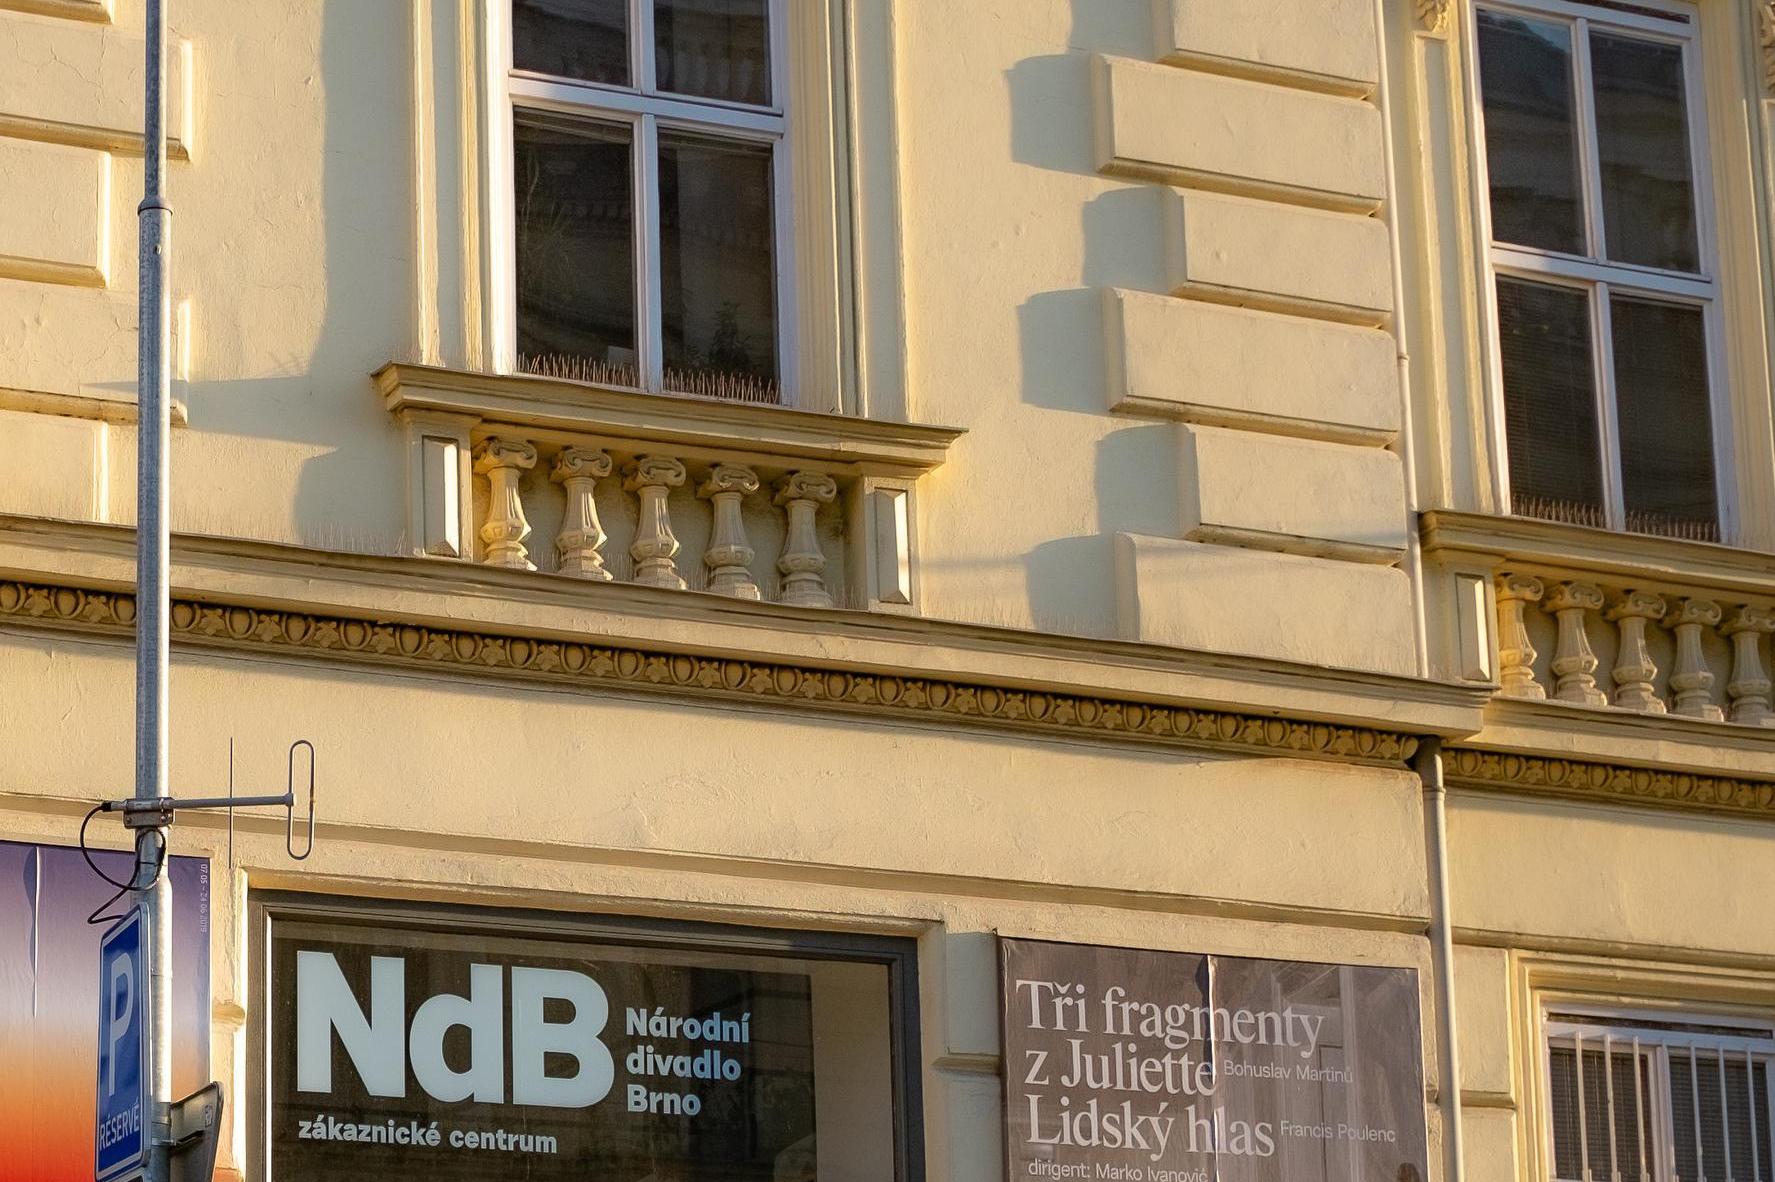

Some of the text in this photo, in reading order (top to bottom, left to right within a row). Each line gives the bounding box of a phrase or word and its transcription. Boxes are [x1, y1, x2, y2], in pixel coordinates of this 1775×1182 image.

[108, 952, 134, 1097] P
[297, 950, 615, 1109] NdB
[626, 1006, 751, 1045] Národní
[1016, 979, 1325, 1059] Tři fragmenty
[626, 1046, 742, 1081] divadlo
[1025, 1038, 1215, 1096] z Juliette
[1223, 1060, 1353, 1084] Bohuslav Martinů
[627, 1085, 701, 1117] Brno
[99, 1096, 140, 1150] RÉSERVÉ
[298, 1118, 558, 1154] zákaznické centrum
[1025, 1095, 1275, 1161] Lidský hlas
[1280, 1120, 1396, 1143] Francis Poulenc
[1028, 1159, 1091, 1182] dirigent:
[1095, 1163, 1143, 1182] Marko
